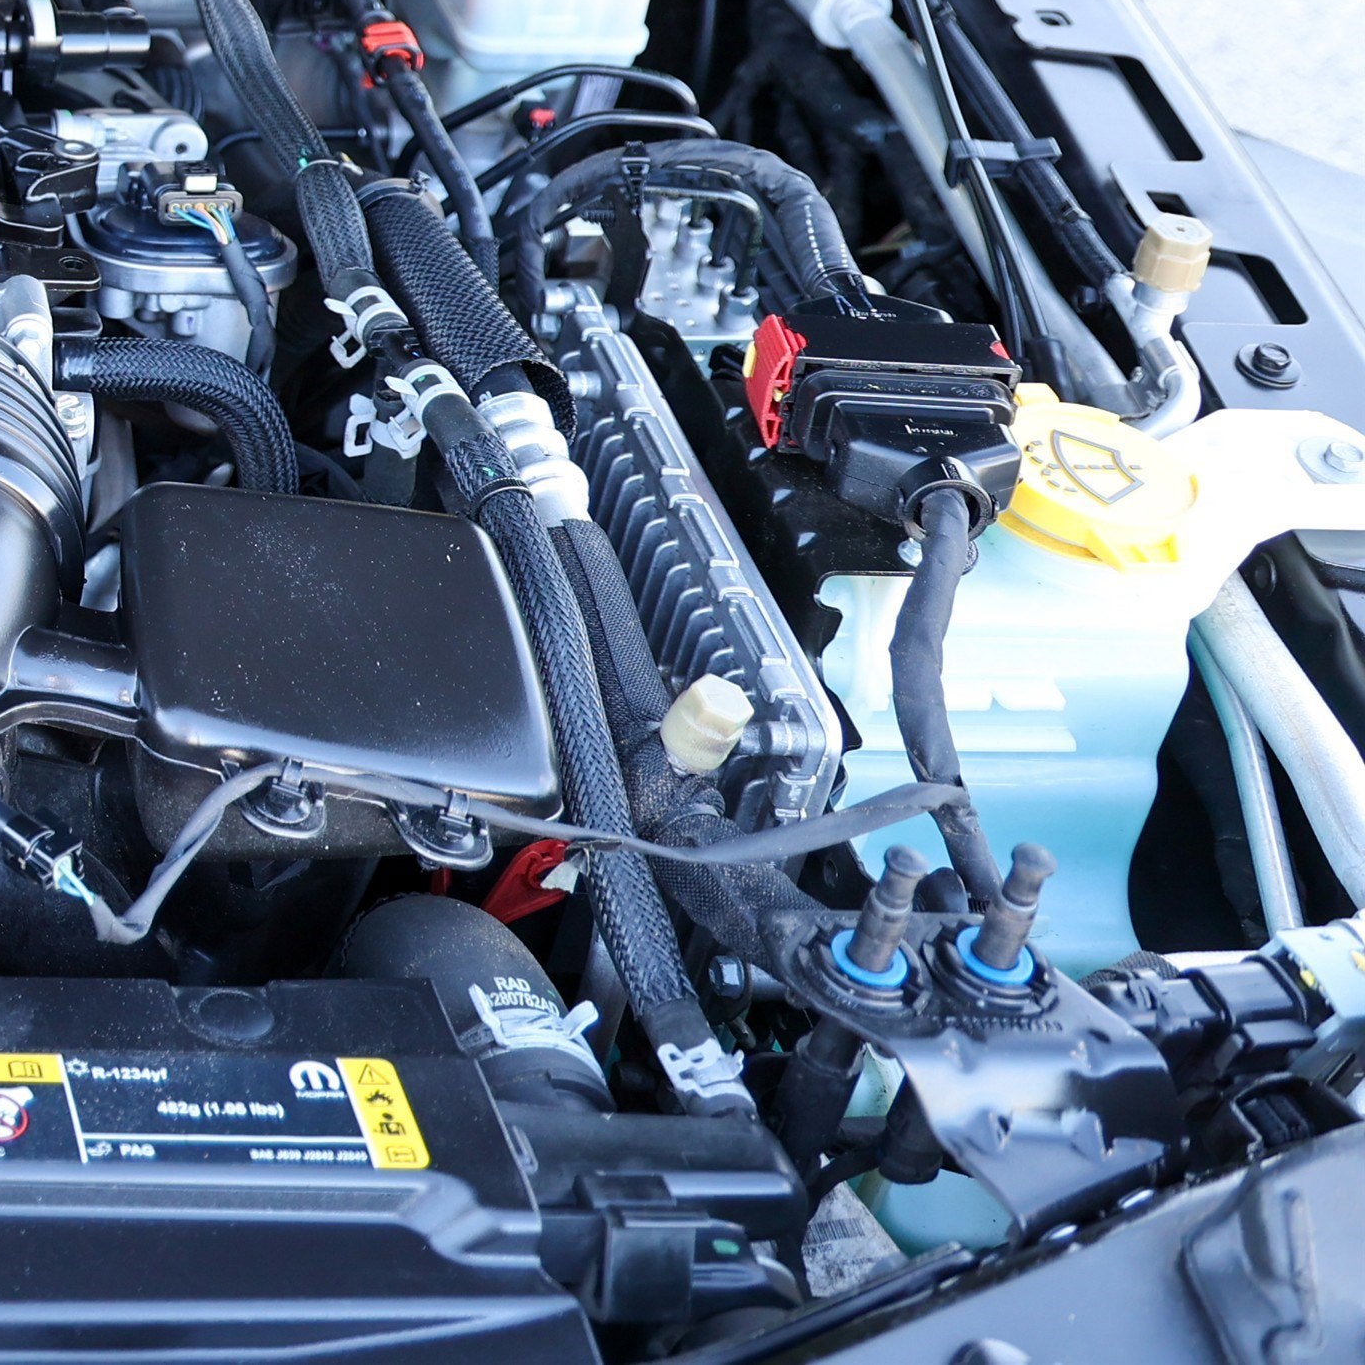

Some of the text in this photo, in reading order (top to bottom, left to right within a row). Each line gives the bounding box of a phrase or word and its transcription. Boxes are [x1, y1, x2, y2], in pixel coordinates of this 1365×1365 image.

[493, 977, 531, 992] RAD
[91, 1066, 168, 1082] R-1234yf
[249, 1102, 285, 1119] lbs)
